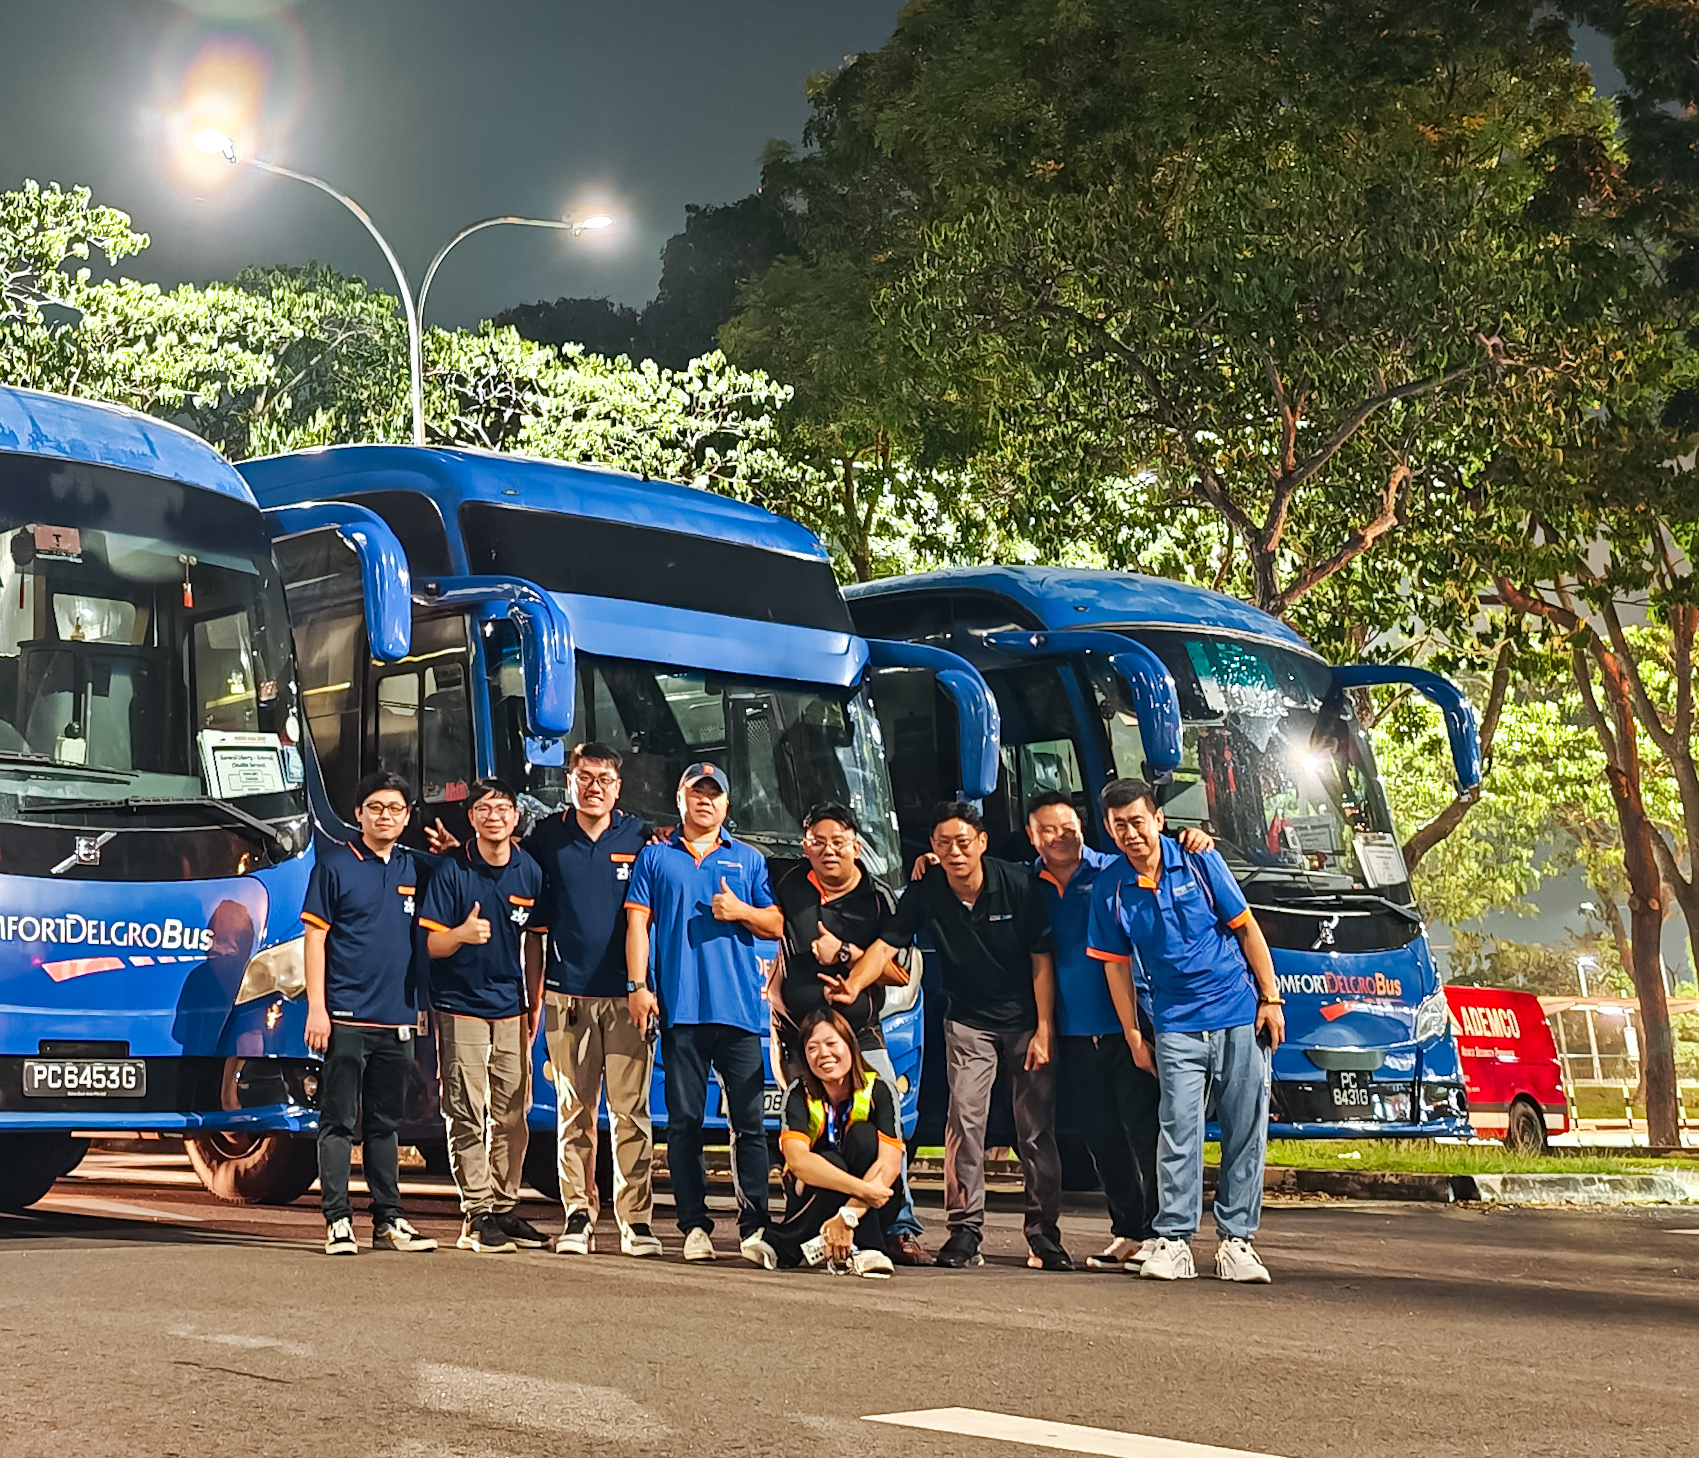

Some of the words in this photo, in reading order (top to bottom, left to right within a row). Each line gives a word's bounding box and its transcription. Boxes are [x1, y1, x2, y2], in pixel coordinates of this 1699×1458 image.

[1460, 1006, 1521, 1039] ADEMCO
[1340, 1072, 1358, 1089] PC
[1333, 1089, 1369, 1106] 8431G
